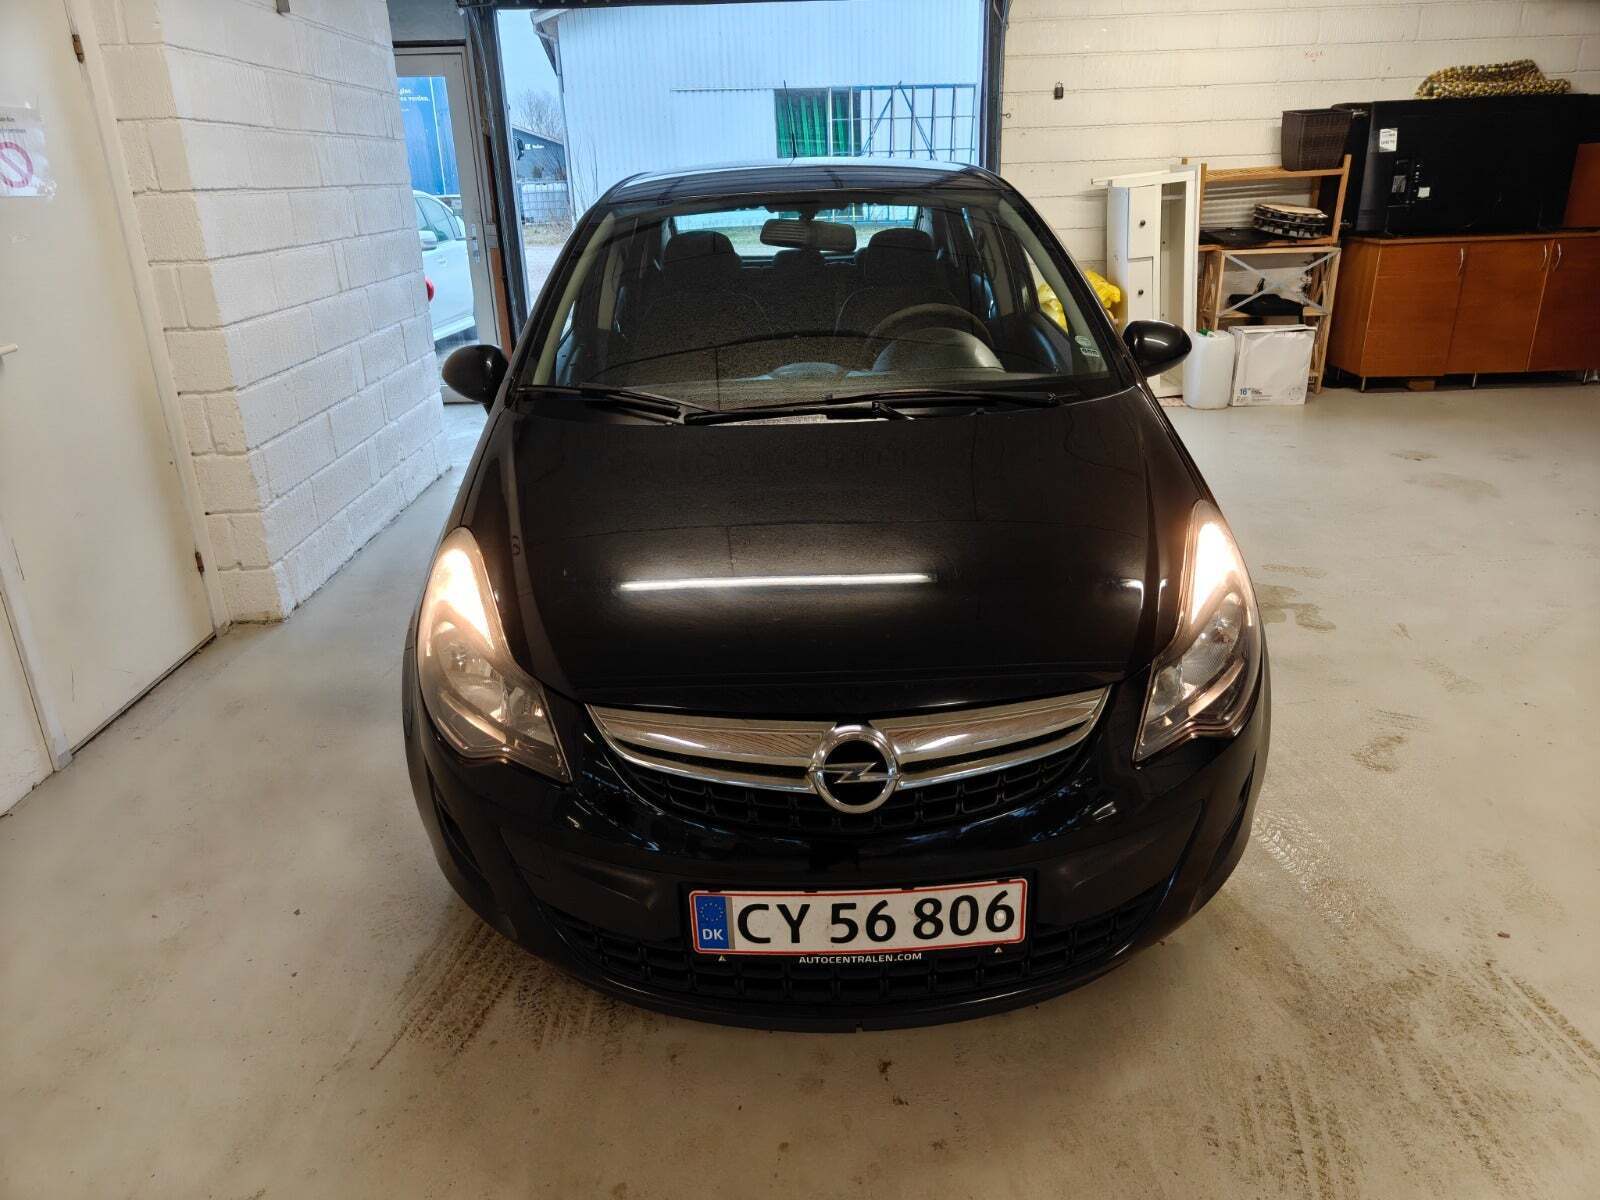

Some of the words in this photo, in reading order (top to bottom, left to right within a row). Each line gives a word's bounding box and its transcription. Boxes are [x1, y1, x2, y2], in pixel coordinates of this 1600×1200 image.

[737, 903, 811, 944] CY
[830, 899, 896, 944] 56
[913, 890, 1015, 940] 806
[702, 928, 724, 940] DK
[799, 952, 922, 964] AUTOCENTRALEN.COM
